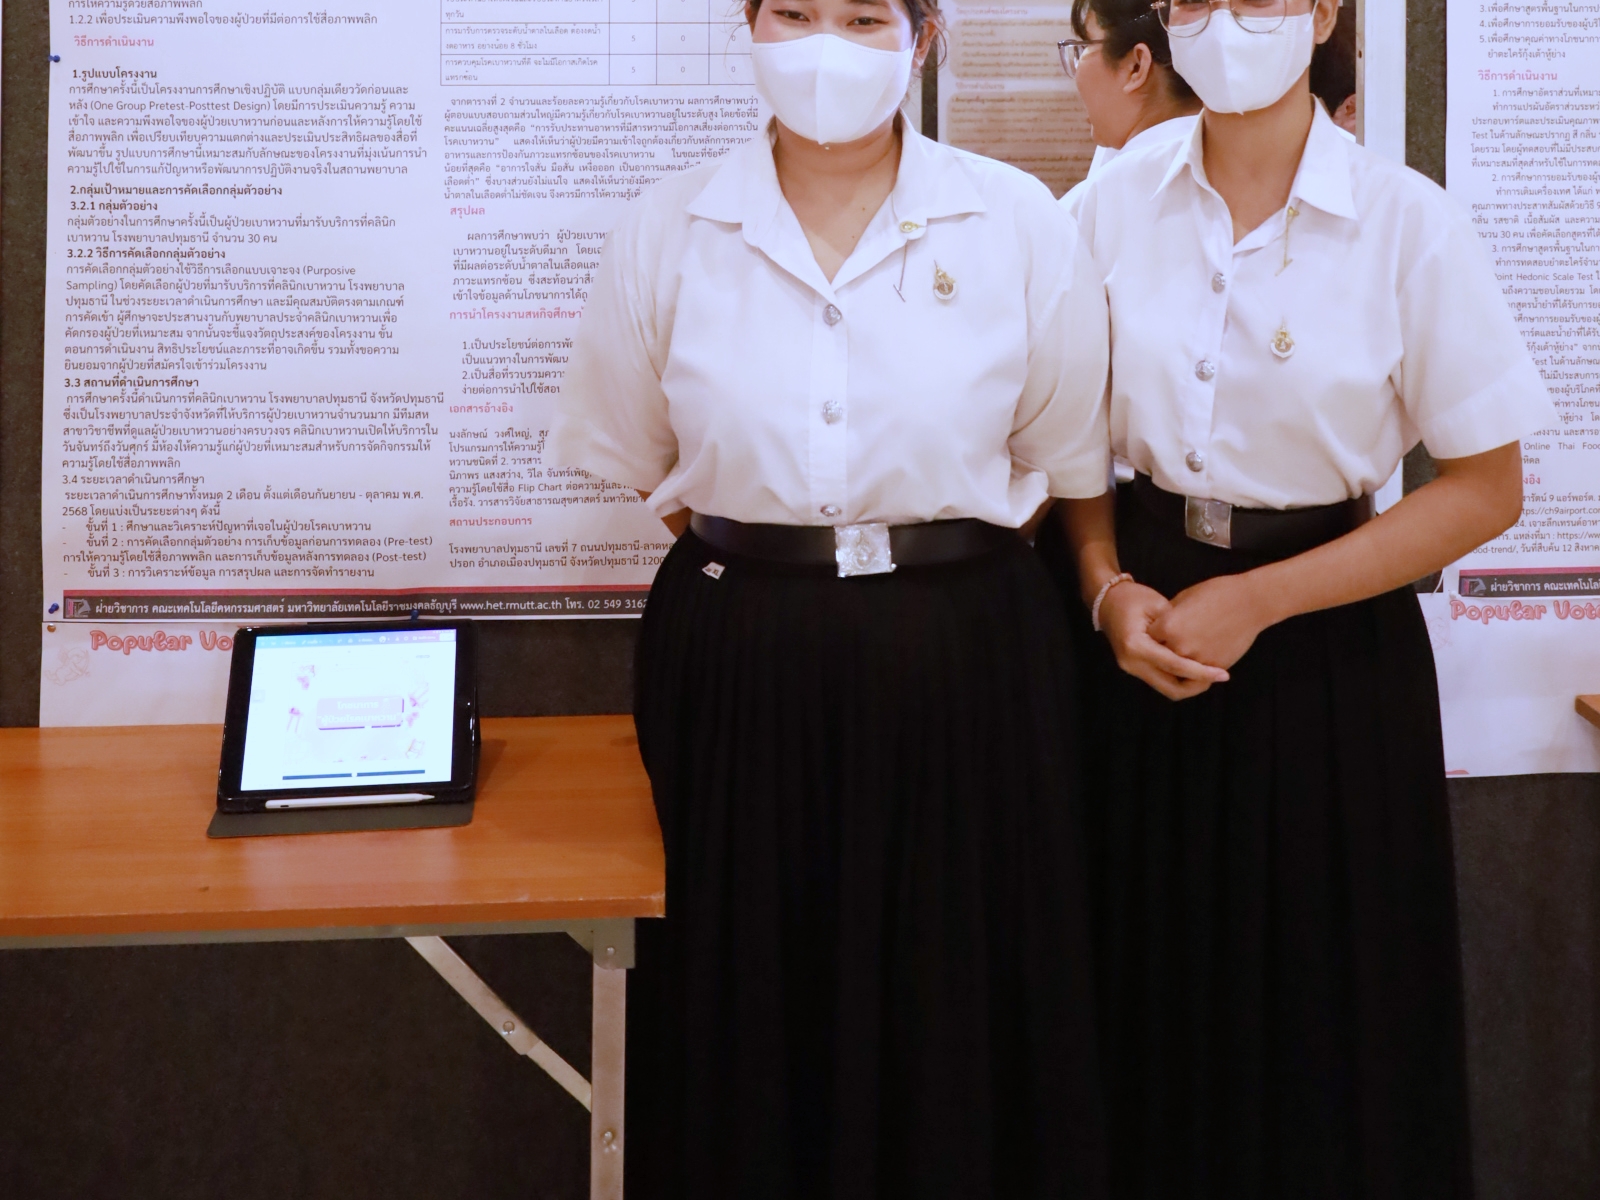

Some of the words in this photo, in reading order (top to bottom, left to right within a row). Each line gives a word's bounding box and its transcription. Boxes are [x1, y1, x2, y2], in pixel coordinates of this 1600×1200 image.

[69, 14, 93, 24] 1.2.2
[68, 99, 88, 111] หลัง
[89, 100, 114, 113] (One
[115, 101, 147, 113] Group
[233, 100, 271, 113] Design)
[388, 103, 416, 111] ความ
[500, 96, 506, 106] 2
[69, 201, 96, 211] 3.2.1
[449, 203, 486, 219] สรุปผล
[66, 248, 94, 258] 3.2.2
[63, 377, 82, 387] 3.3
[1523, 440, 1551, 451] Online
[1557, 440, 1576, 450] Thai
[500, 455, 509, 466] 2.
[61, 474, 79, 484] 3.4
[517, 481, 536, 494] Flip
[537, 481, 563, 492] Chart
[61, 506, 89, 516] 2568
[199, 501, 221, 516] ดังนี้
[544, 538, 569, 553] เลขที่
[570, 542, 578, 552] 7
[448, 557, 476, 569] ปรอก
[86, 563, 111, 578] ขั้นที่
[112, 567, 120, 577] 3
[564, 597, 586, 609] โทร.
[587, 598, 601, 609] 02
[602, 598, 622, 608] 549
[1449, 600, 1547, 625] Popular
[90, 629, 193, 656] Popular
[199, 630, 235, 651] Vo
